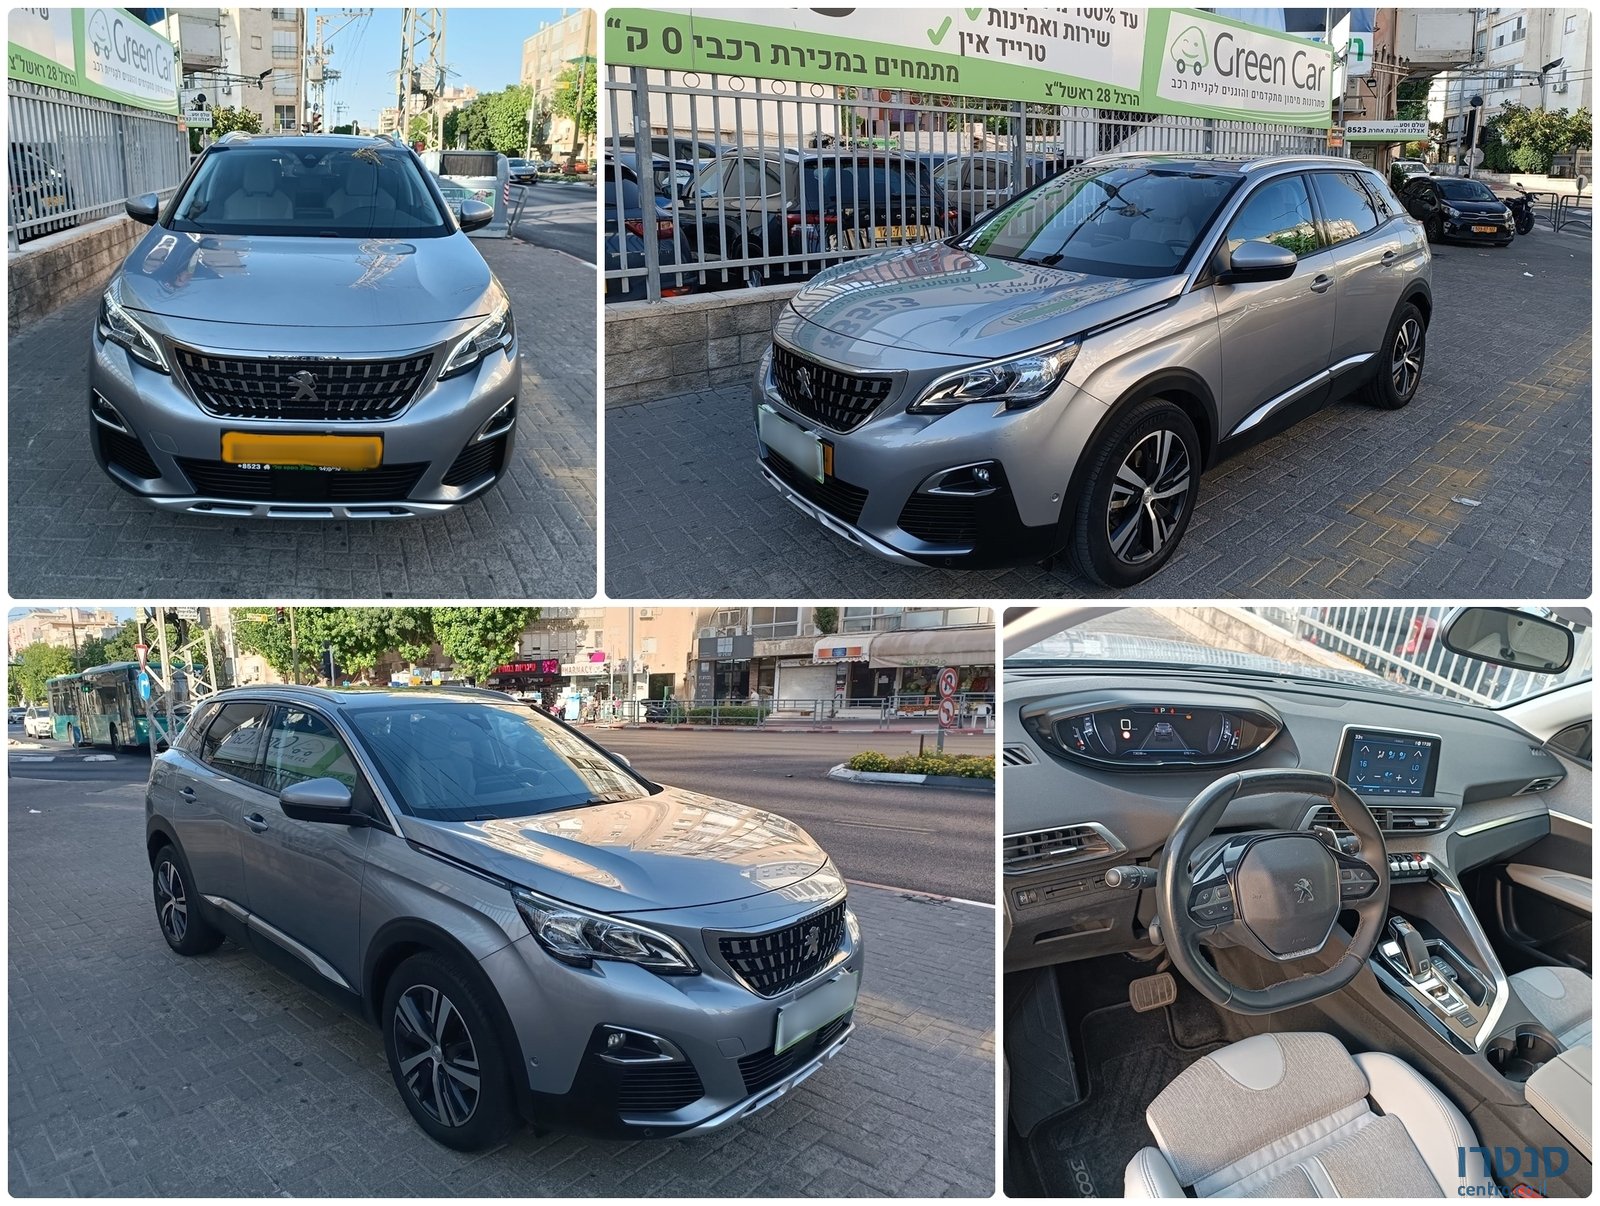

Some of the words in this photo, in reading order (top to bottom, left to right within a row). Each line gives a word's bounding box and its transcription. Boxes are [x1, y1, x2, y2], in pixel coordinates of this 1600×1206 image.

[987, 8, 1058, 38] ואמינות
[1120, 11, 1138, 29] עד
[662, 27, 683, 55] 0
[959, 31, 989, 57] אין
[1062, 22, 1110, 48] שירות
[113, 19, 154, 73] Green
[155, 44, 172, 83] Car
[693, 34, 761, 63] רכבי
[770, 44, 867, 74] במכירת
[996, 37, 1046, 62] טרייד
[47, 64, 58, 81] 28
[875, 56, 959, 83] מתמחים
[1213, 32, 1286, 86] Green
[1292, 50, 1325, 92] Car
[58, 67, 77, 87] הרצל
[1171, 78, 1188, 90] רכב
[1191, 81, 1219, 95] לקניית
[1096, 87, 1111, 103] 28
[1114, 89, 1140, 106] הרצל
[1222, 86, 1248, 98] והוגנים
[1251, 90, 1282, 103] מתקדמים
[1284, 95, 1301, 106] מימון
[1070, 1159, 1097, 1198] 300
